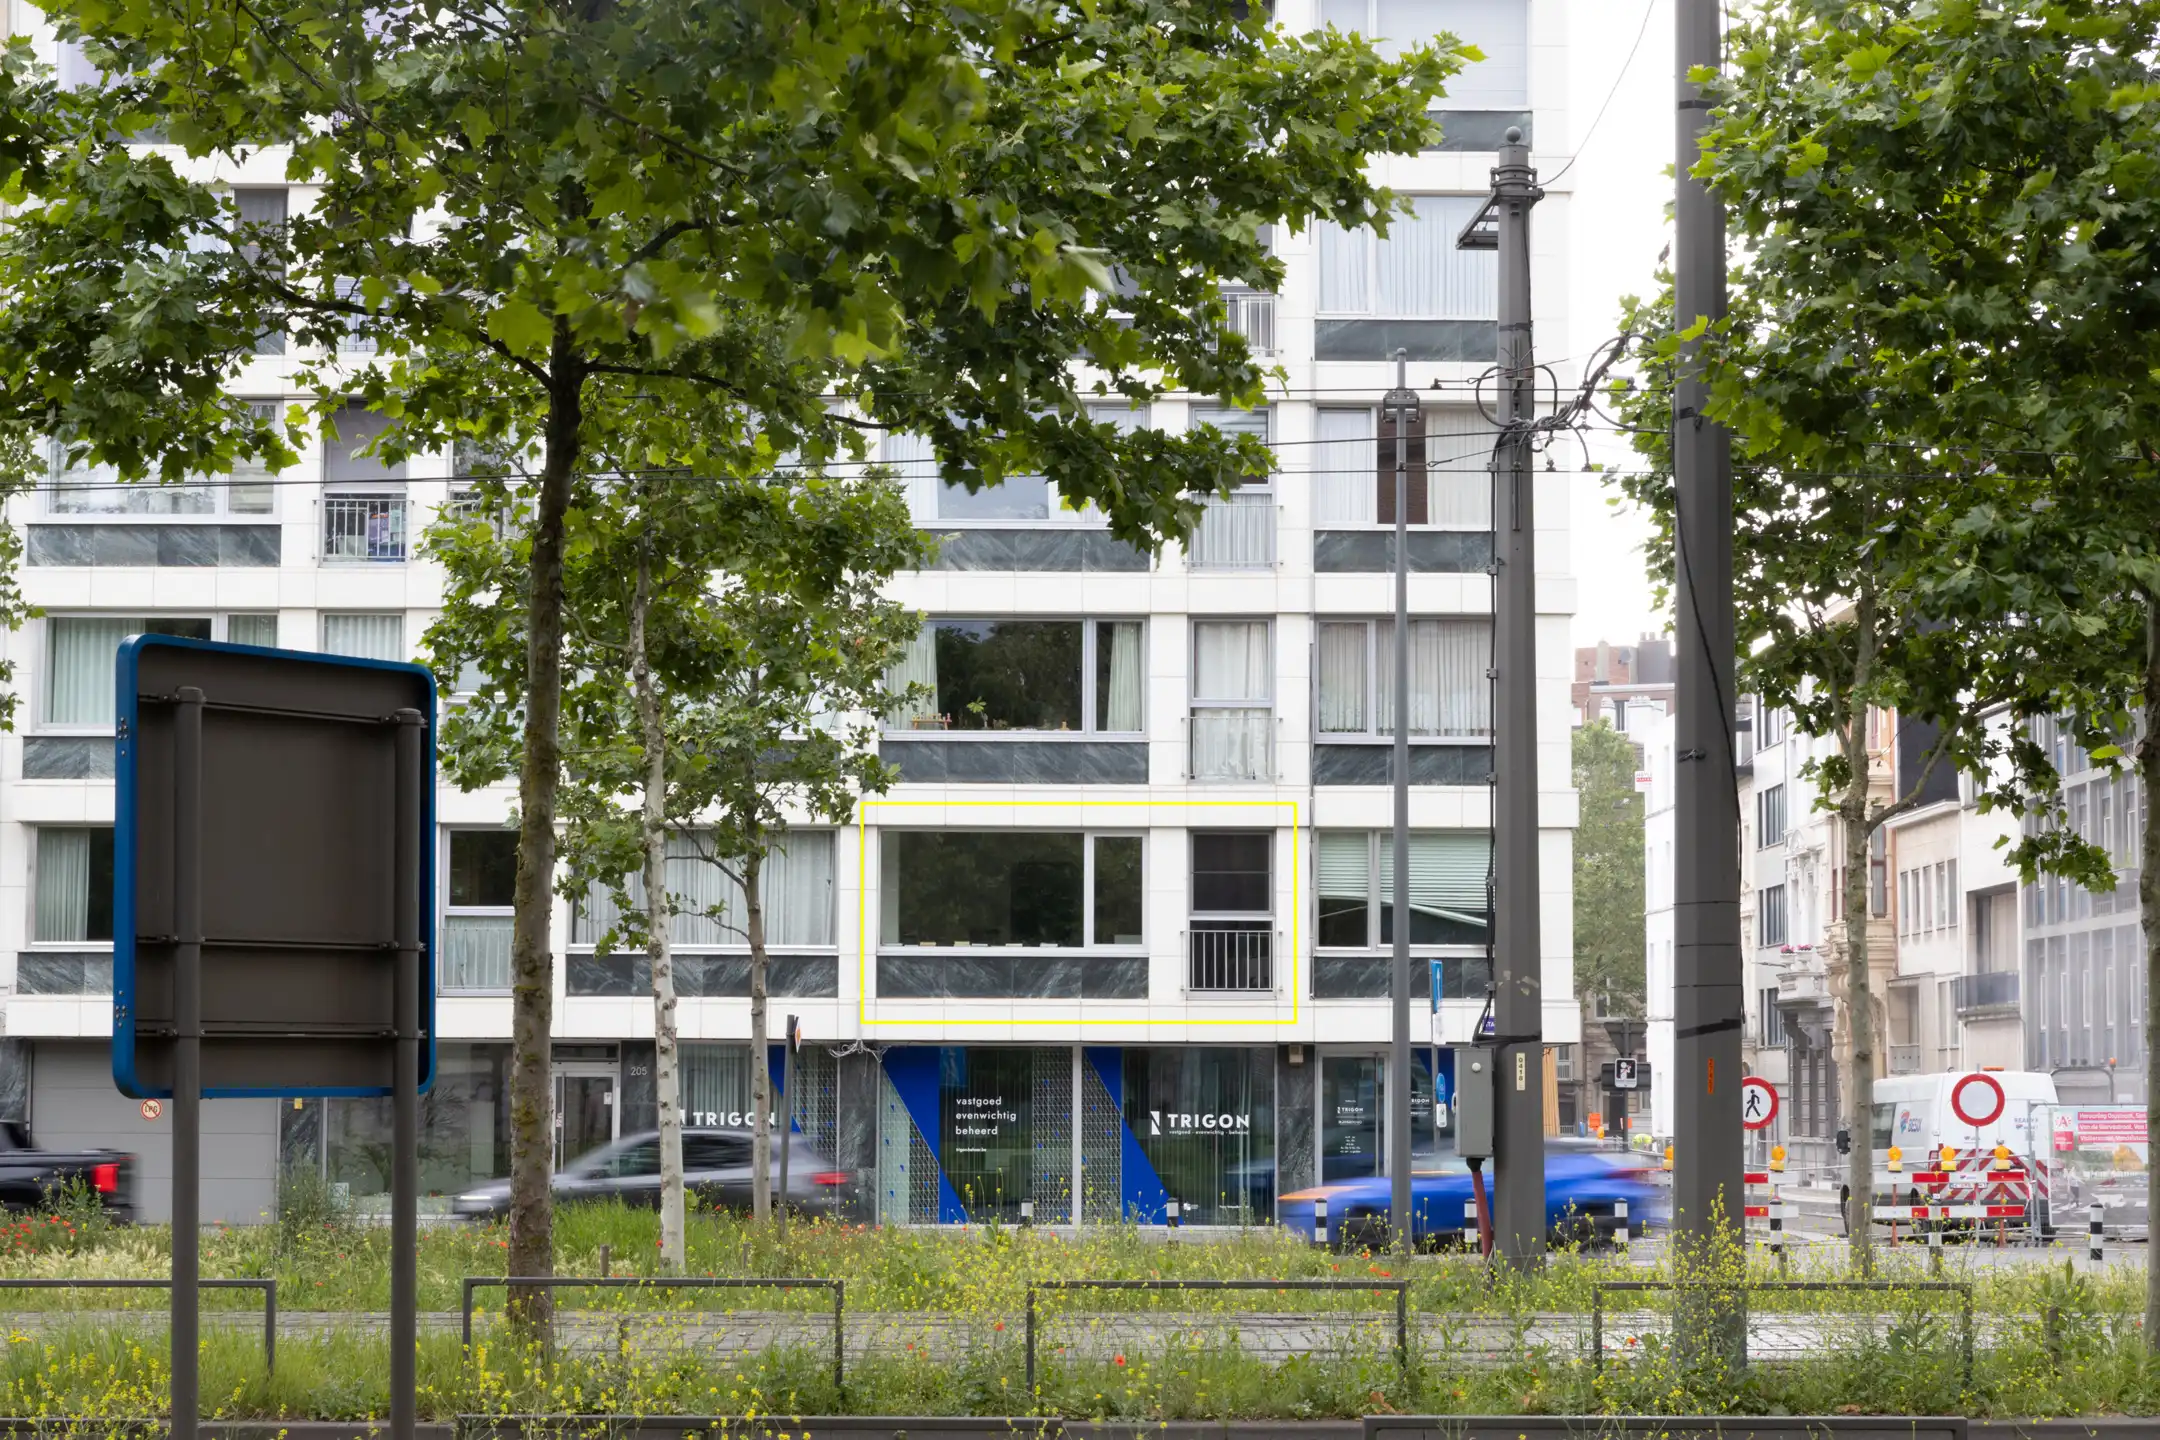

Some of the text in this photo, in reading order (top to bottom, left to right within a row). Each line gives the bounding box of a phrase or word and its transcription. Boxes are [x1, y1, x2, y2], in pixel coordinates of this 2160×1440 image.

[630, 1066, 648, 1076] 205
[956, 1096, 1002, 1108] vastgoed
[144, 1105, 158, 1113] LPG
[955, 1110, 1017, 1122] evenwichtig
[1167, 1113, 1250, 1129] TRIGON
[955, 1125, 998, 1135] beheerd
